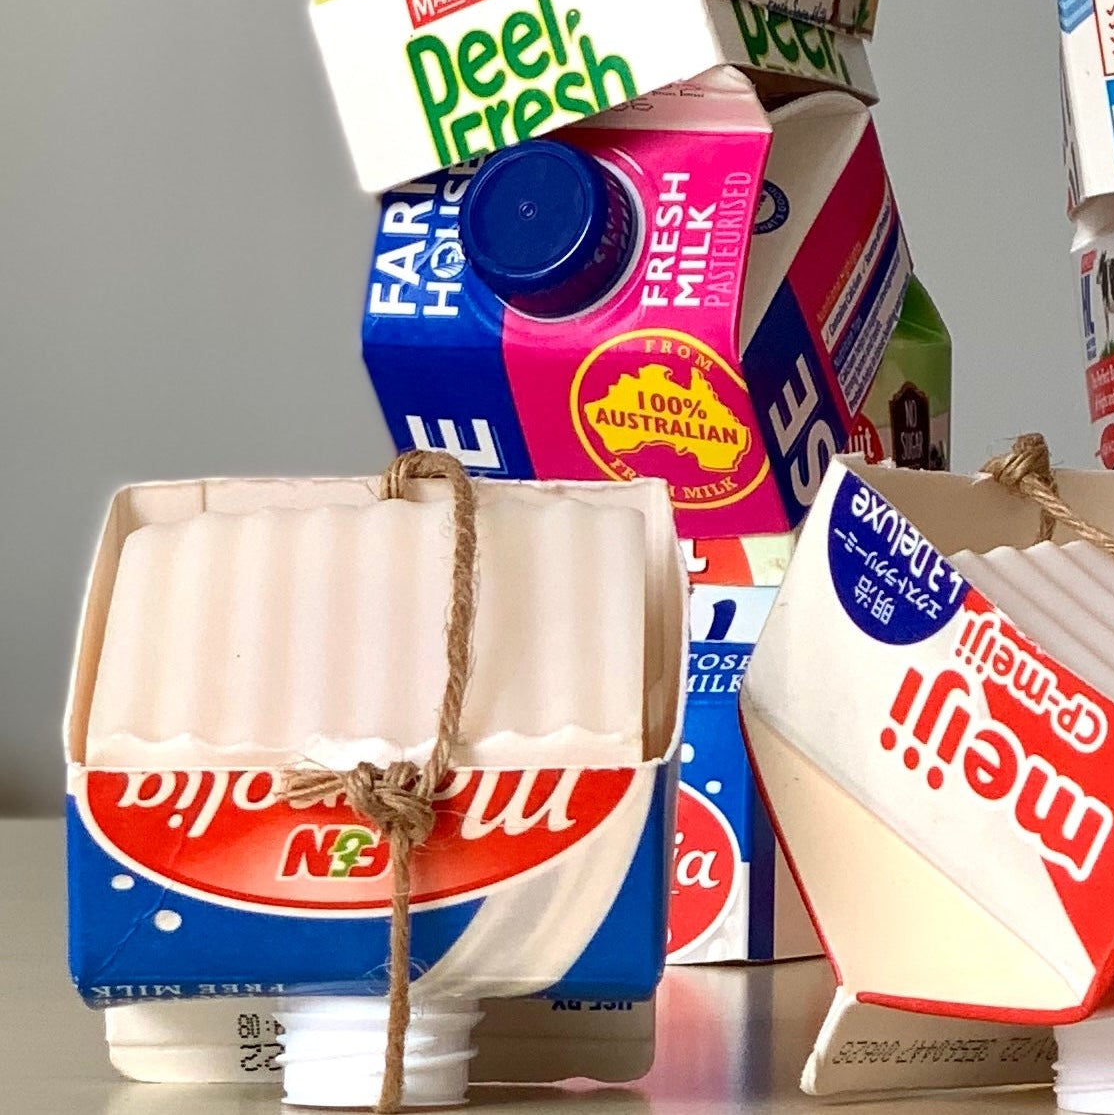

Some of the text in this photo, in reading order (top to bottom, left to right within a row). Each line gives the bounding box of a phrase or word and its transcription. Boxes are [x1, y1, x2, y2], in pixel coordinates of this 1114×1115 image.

[450, 35, 639, 163] Fresh
[641, 172, 691, 307] FRESH
[673, 202, 718, 307] MILK
[704, 171, 753, 307] PASTEURISED
[645, 339, 714, 373] FROM
[596, 407, 739, 445] AUSTRALIAN
[638, 390, 708, 420] 100%
[682, 476, 738, 499] MILK
[851, 486, 934, 578] Deluxe
[854, 574, 896, 625] 明治
[954, 618, 1101, 745] CP-meiji
[880, 665, 1108, 873] meiji
[90, 983, 285, 997] FREE MILK
